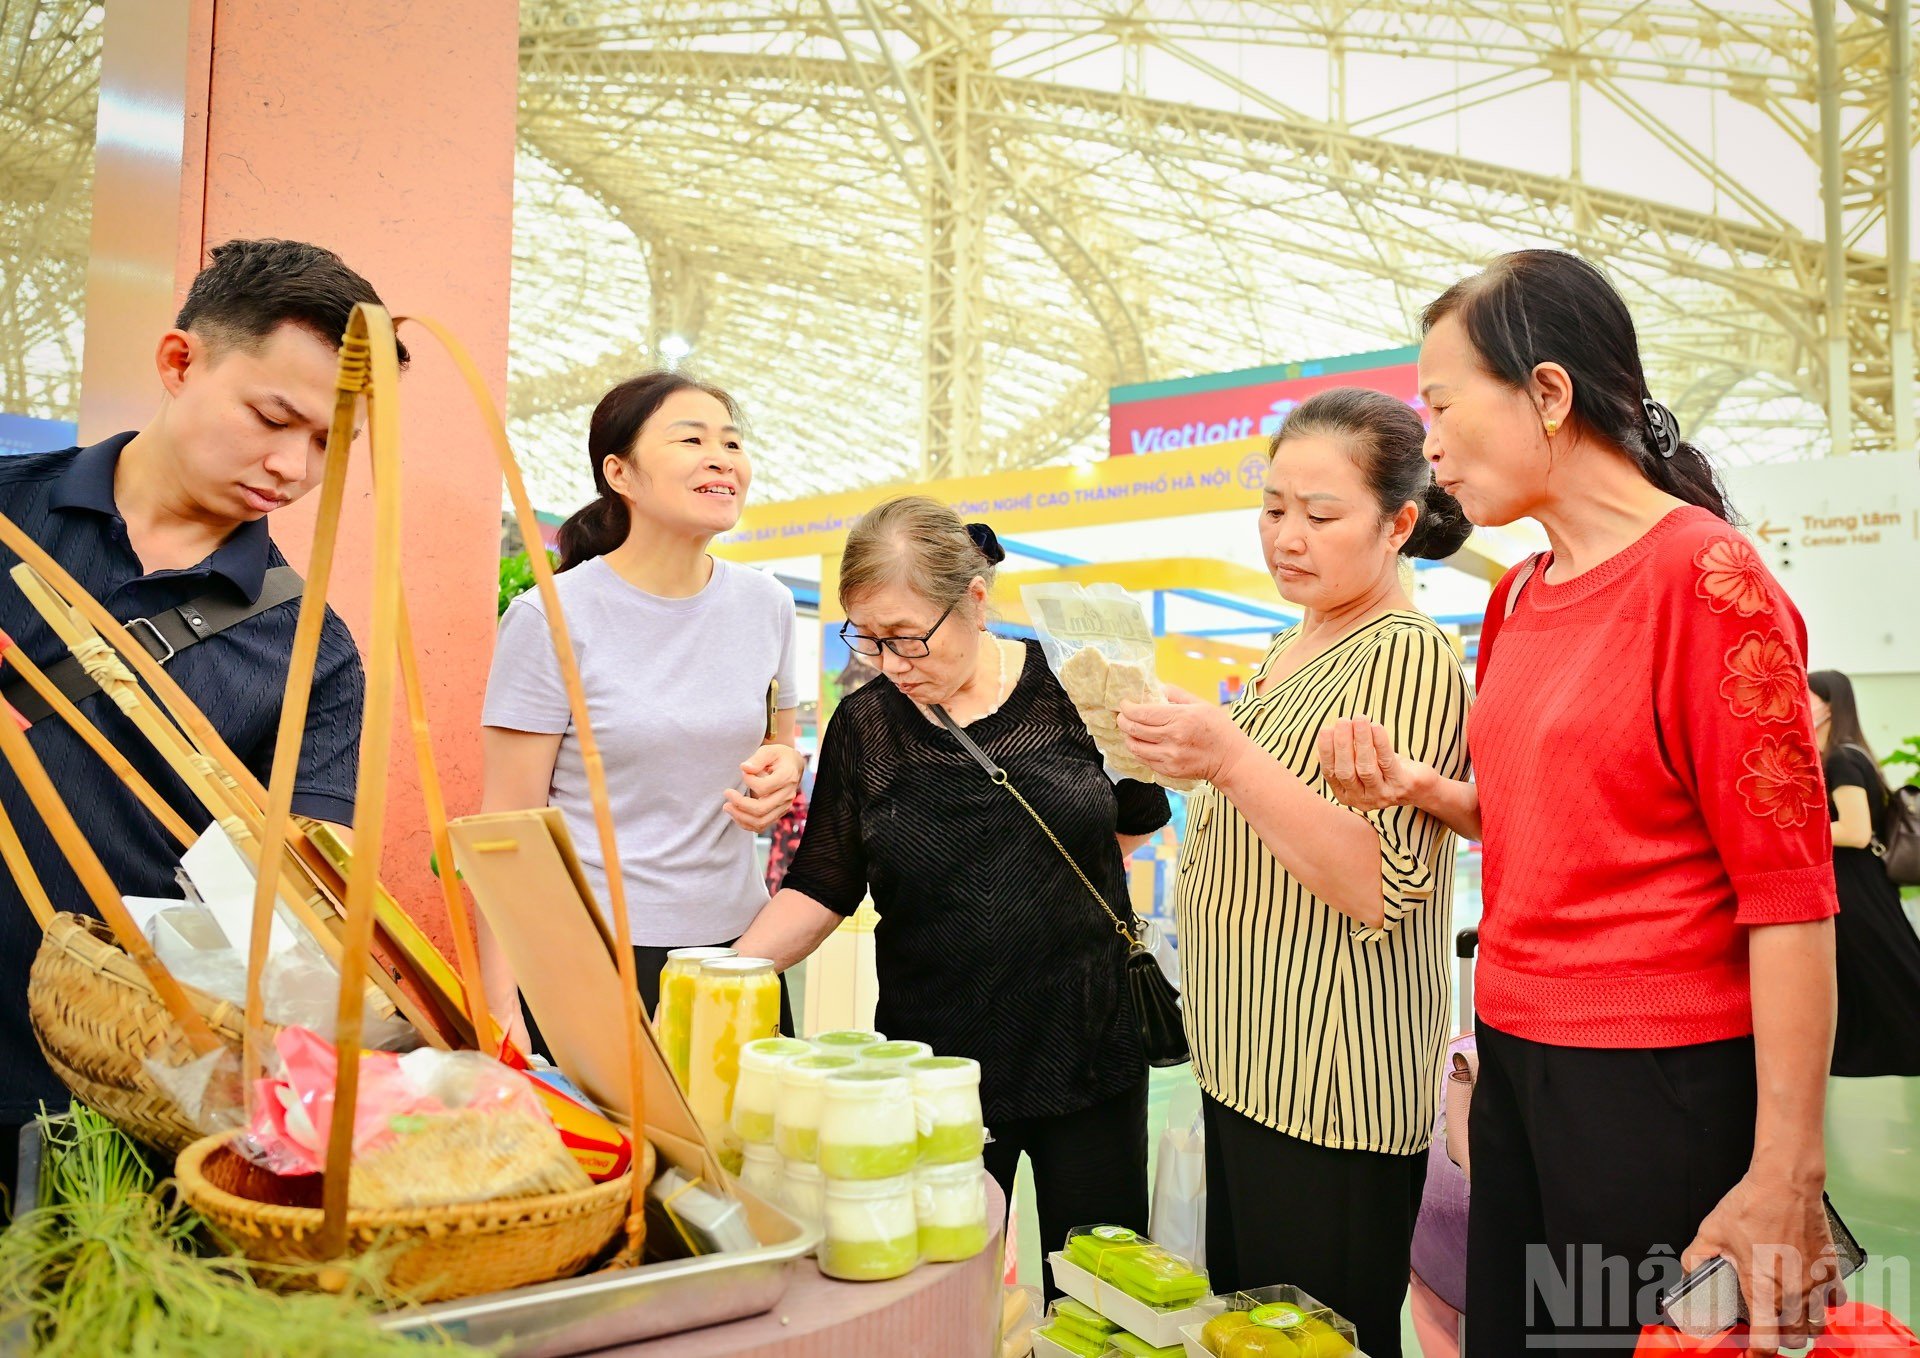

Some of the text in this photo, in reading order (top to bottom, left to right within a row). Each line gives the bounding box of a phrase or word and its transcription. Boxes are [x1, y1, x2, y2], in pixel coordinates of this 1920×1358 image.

[1130, 416, 1253, 456] Vietlott
[993, 493, 1033, 513] NGHỆ
[1037, 491, 1070, 508] CAO
[1074, 484, 1129, 505] THÀNH
[1133, 472, 1168, 495] PHỐ
[1172, 473, 1195, 491] HÀ
[1200, 466, 1231, 487] NỘI
[1801, 511, 1902, 532] Trung tâm
[1801, 532, 1880, 547] Center Hall
